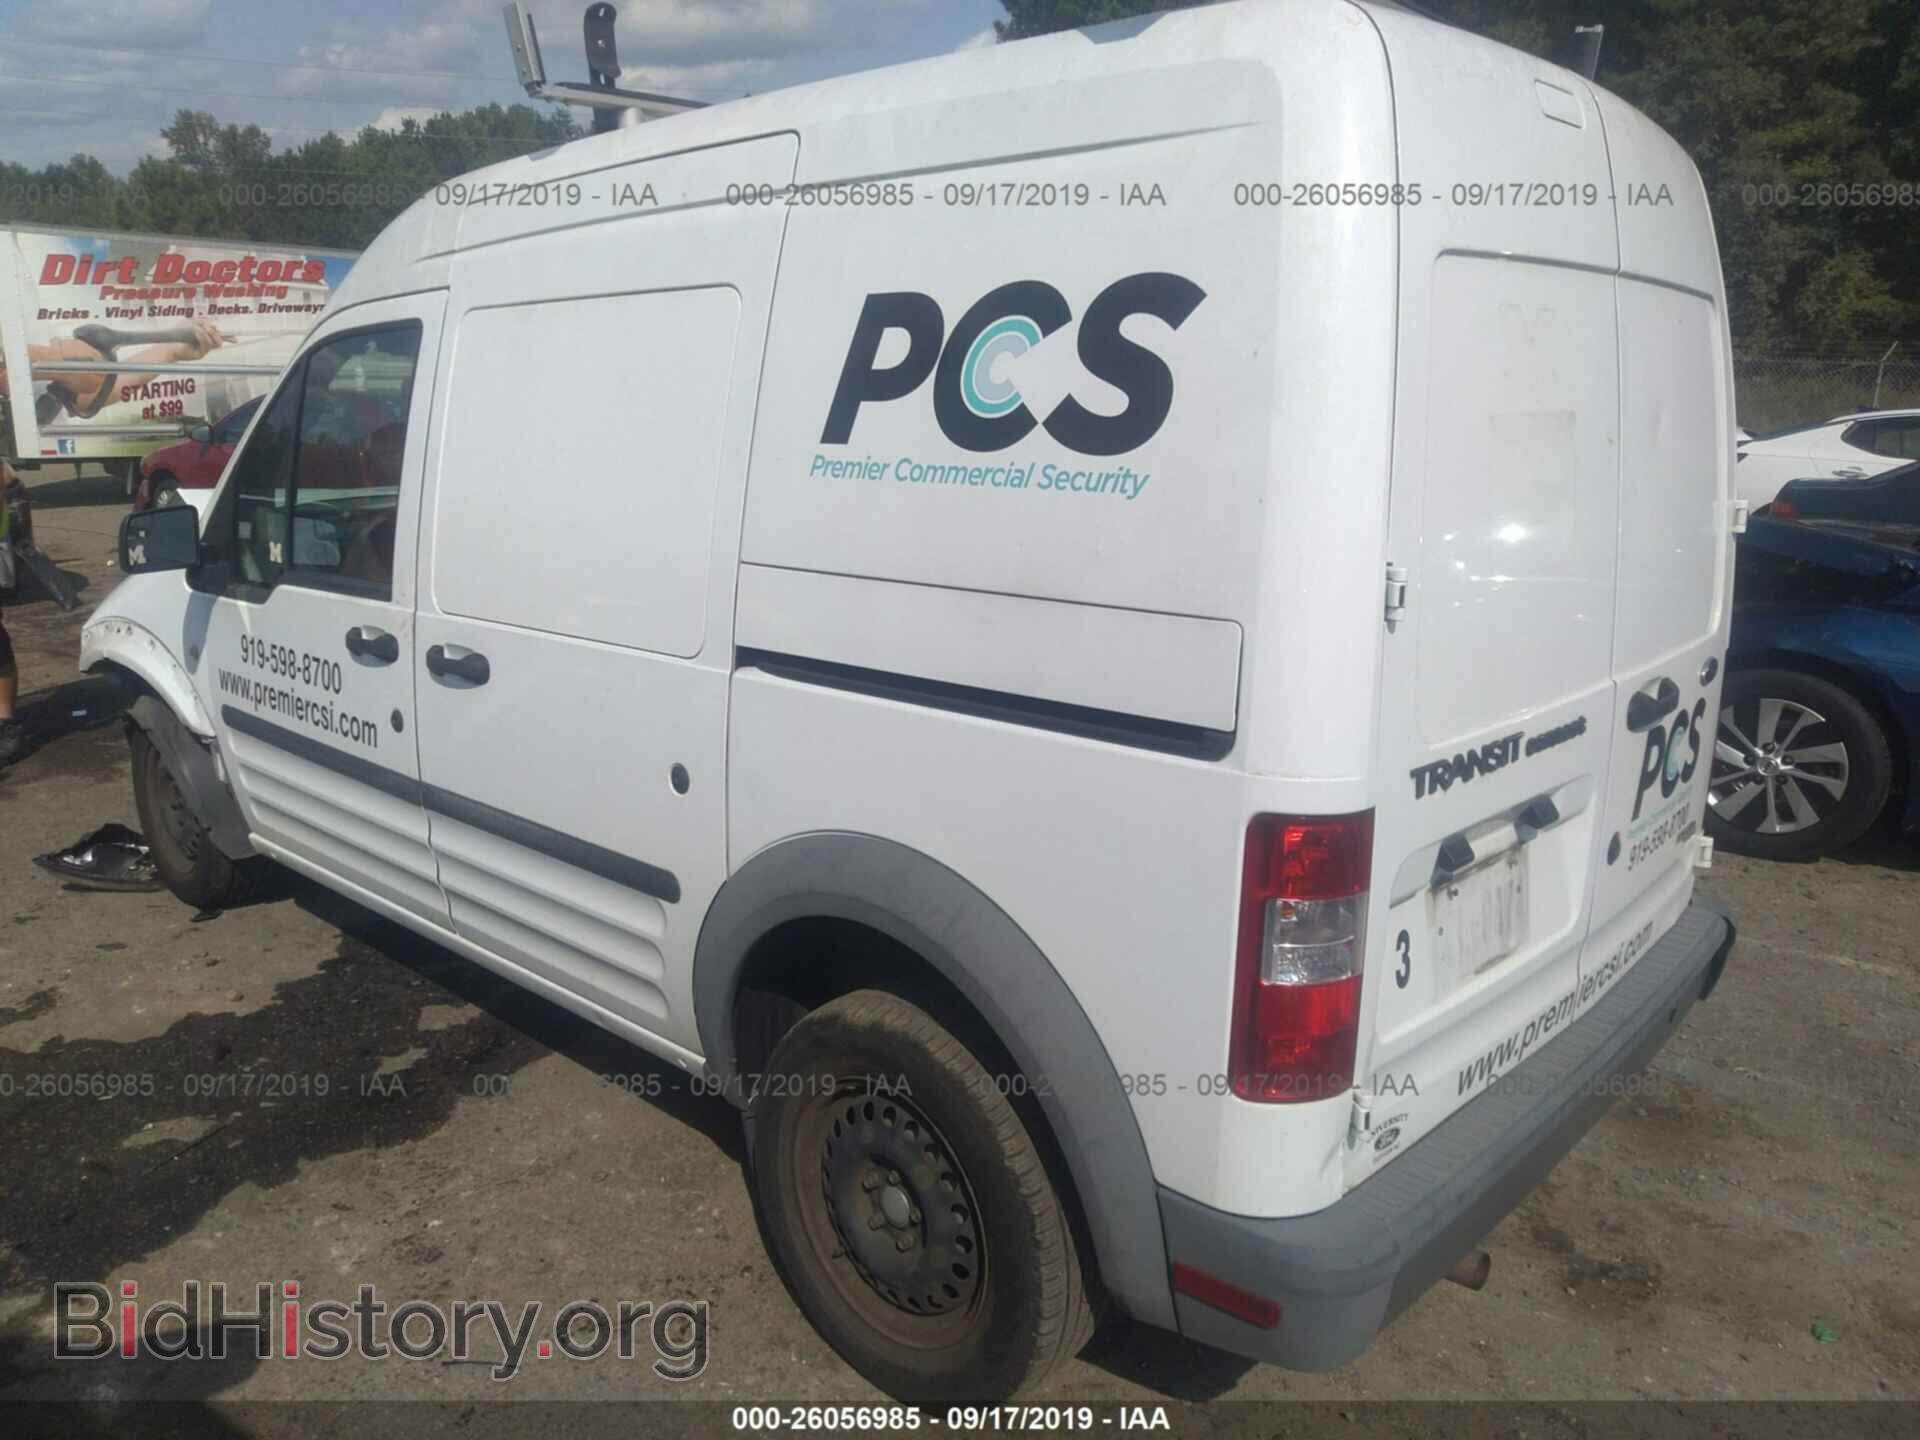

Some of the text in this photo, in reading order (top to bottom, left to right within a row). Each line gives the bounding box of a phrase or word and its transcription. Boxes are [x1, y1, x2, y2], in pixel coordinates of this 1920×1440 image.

[39, 253, 327, 286] Dirt Doctors
[99, 284, 289, 301] Pressure Washing
[37, 307, 90, 321] Bricks
[105, 305, 143, 319] Vinyl
[147, 303, 195, 319] Siding
[120, 377, 196, 403] STARTING
[819, 271, 1208, 457] PCS
[142, 399, 184, 421] at $99
[808, 453, 1151, 501] Premier Commercial Security
[240, 634, 343, 695] 919-598-8700
[218, 667, 378, 748] www.premiercsi.com
[1409, 731, 1526, 800] TRANSIT
[1631, 697, 1707, 823] PCS
[1395, 929, 1411, 989] 3
[1457, 921, 1654, 1096] www.premiercsi.com
